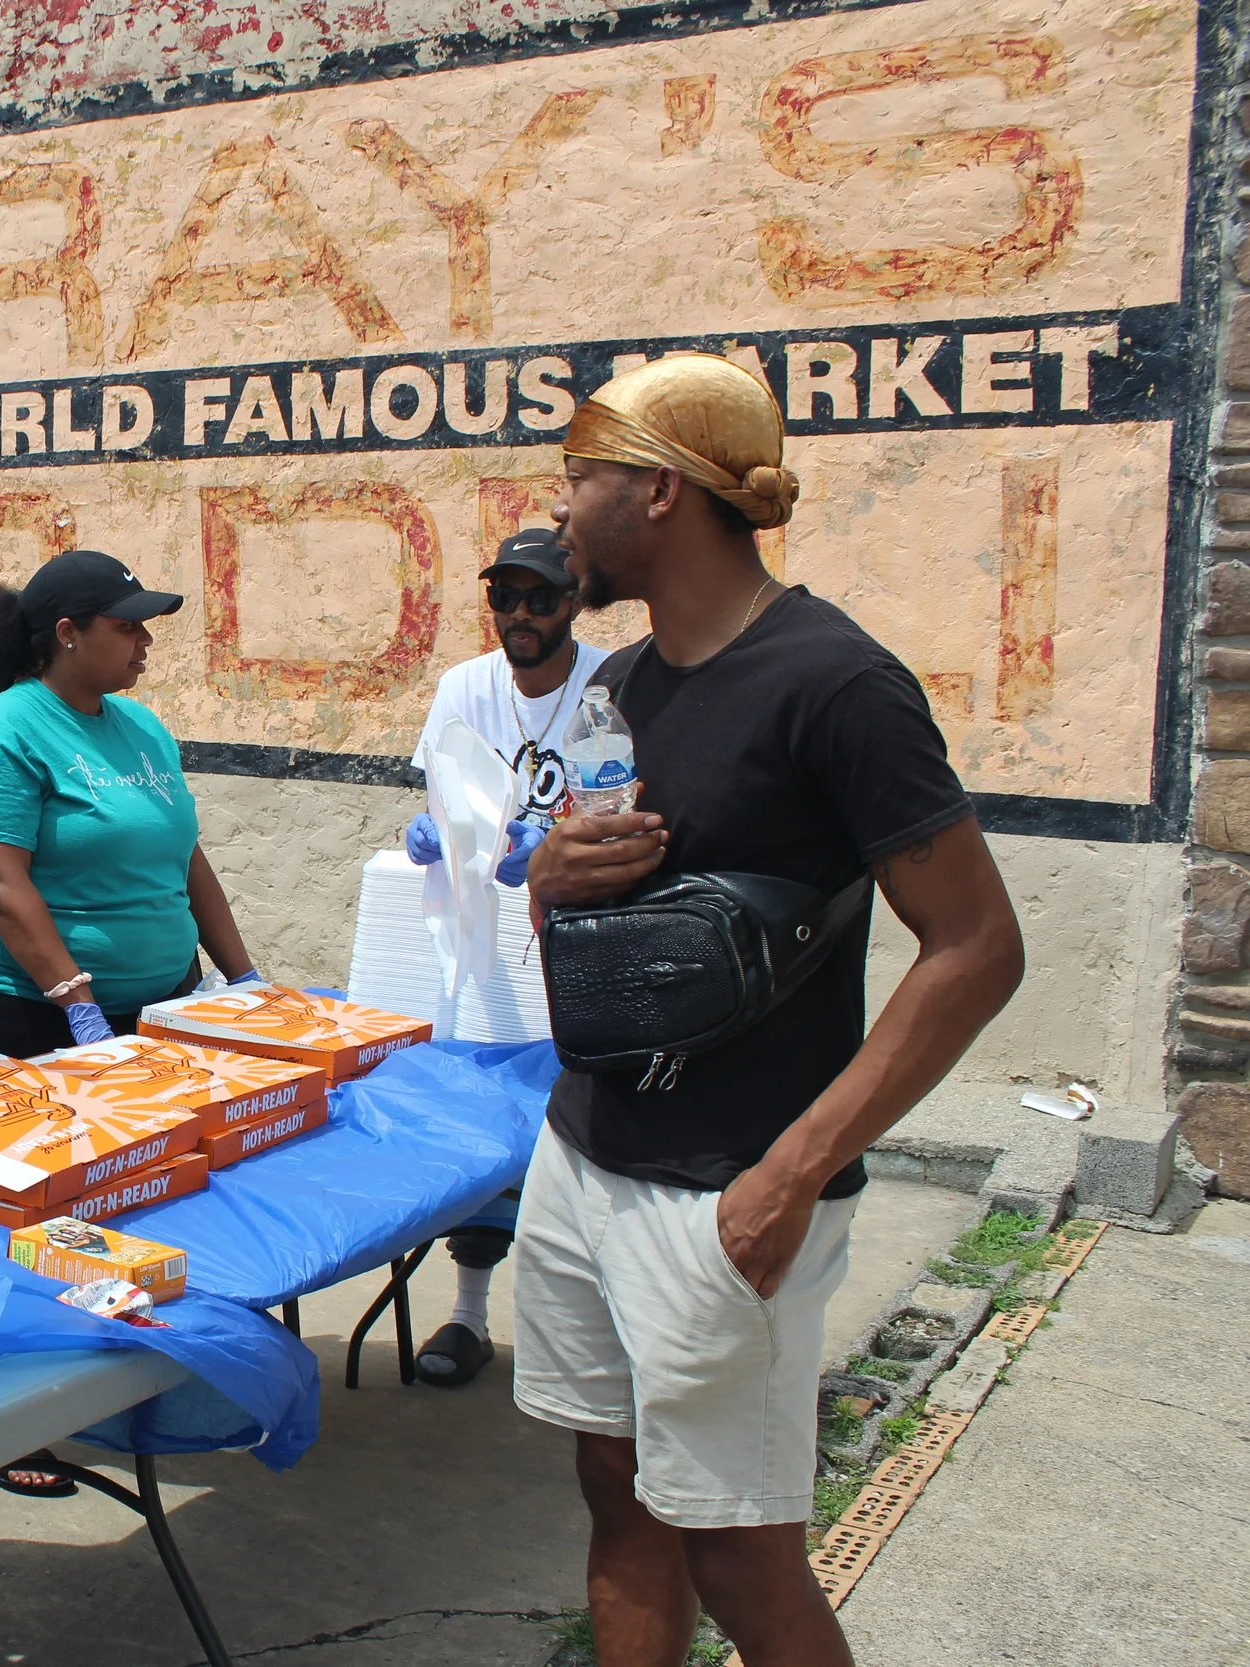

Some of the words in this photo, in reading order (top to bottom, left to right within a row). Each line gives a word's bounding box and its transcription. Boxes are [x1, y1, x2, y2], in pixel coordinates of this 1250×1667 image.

[184, 355, 576, 447] FAMOUS
[613, 322, 1119, 420] RKET
[598, 772, 627, 783] WATER
[358, 1035, 413, 1066] HOT-N-READY
[225, 1085, 299, 1123] HOT-N-READY
[242, 1111, 306, 1151] HOT-N-READY
[85, 1137, 170, 1187] HOT-N-READY
[72, 1175, 172, 1221] HOT-N-READY
